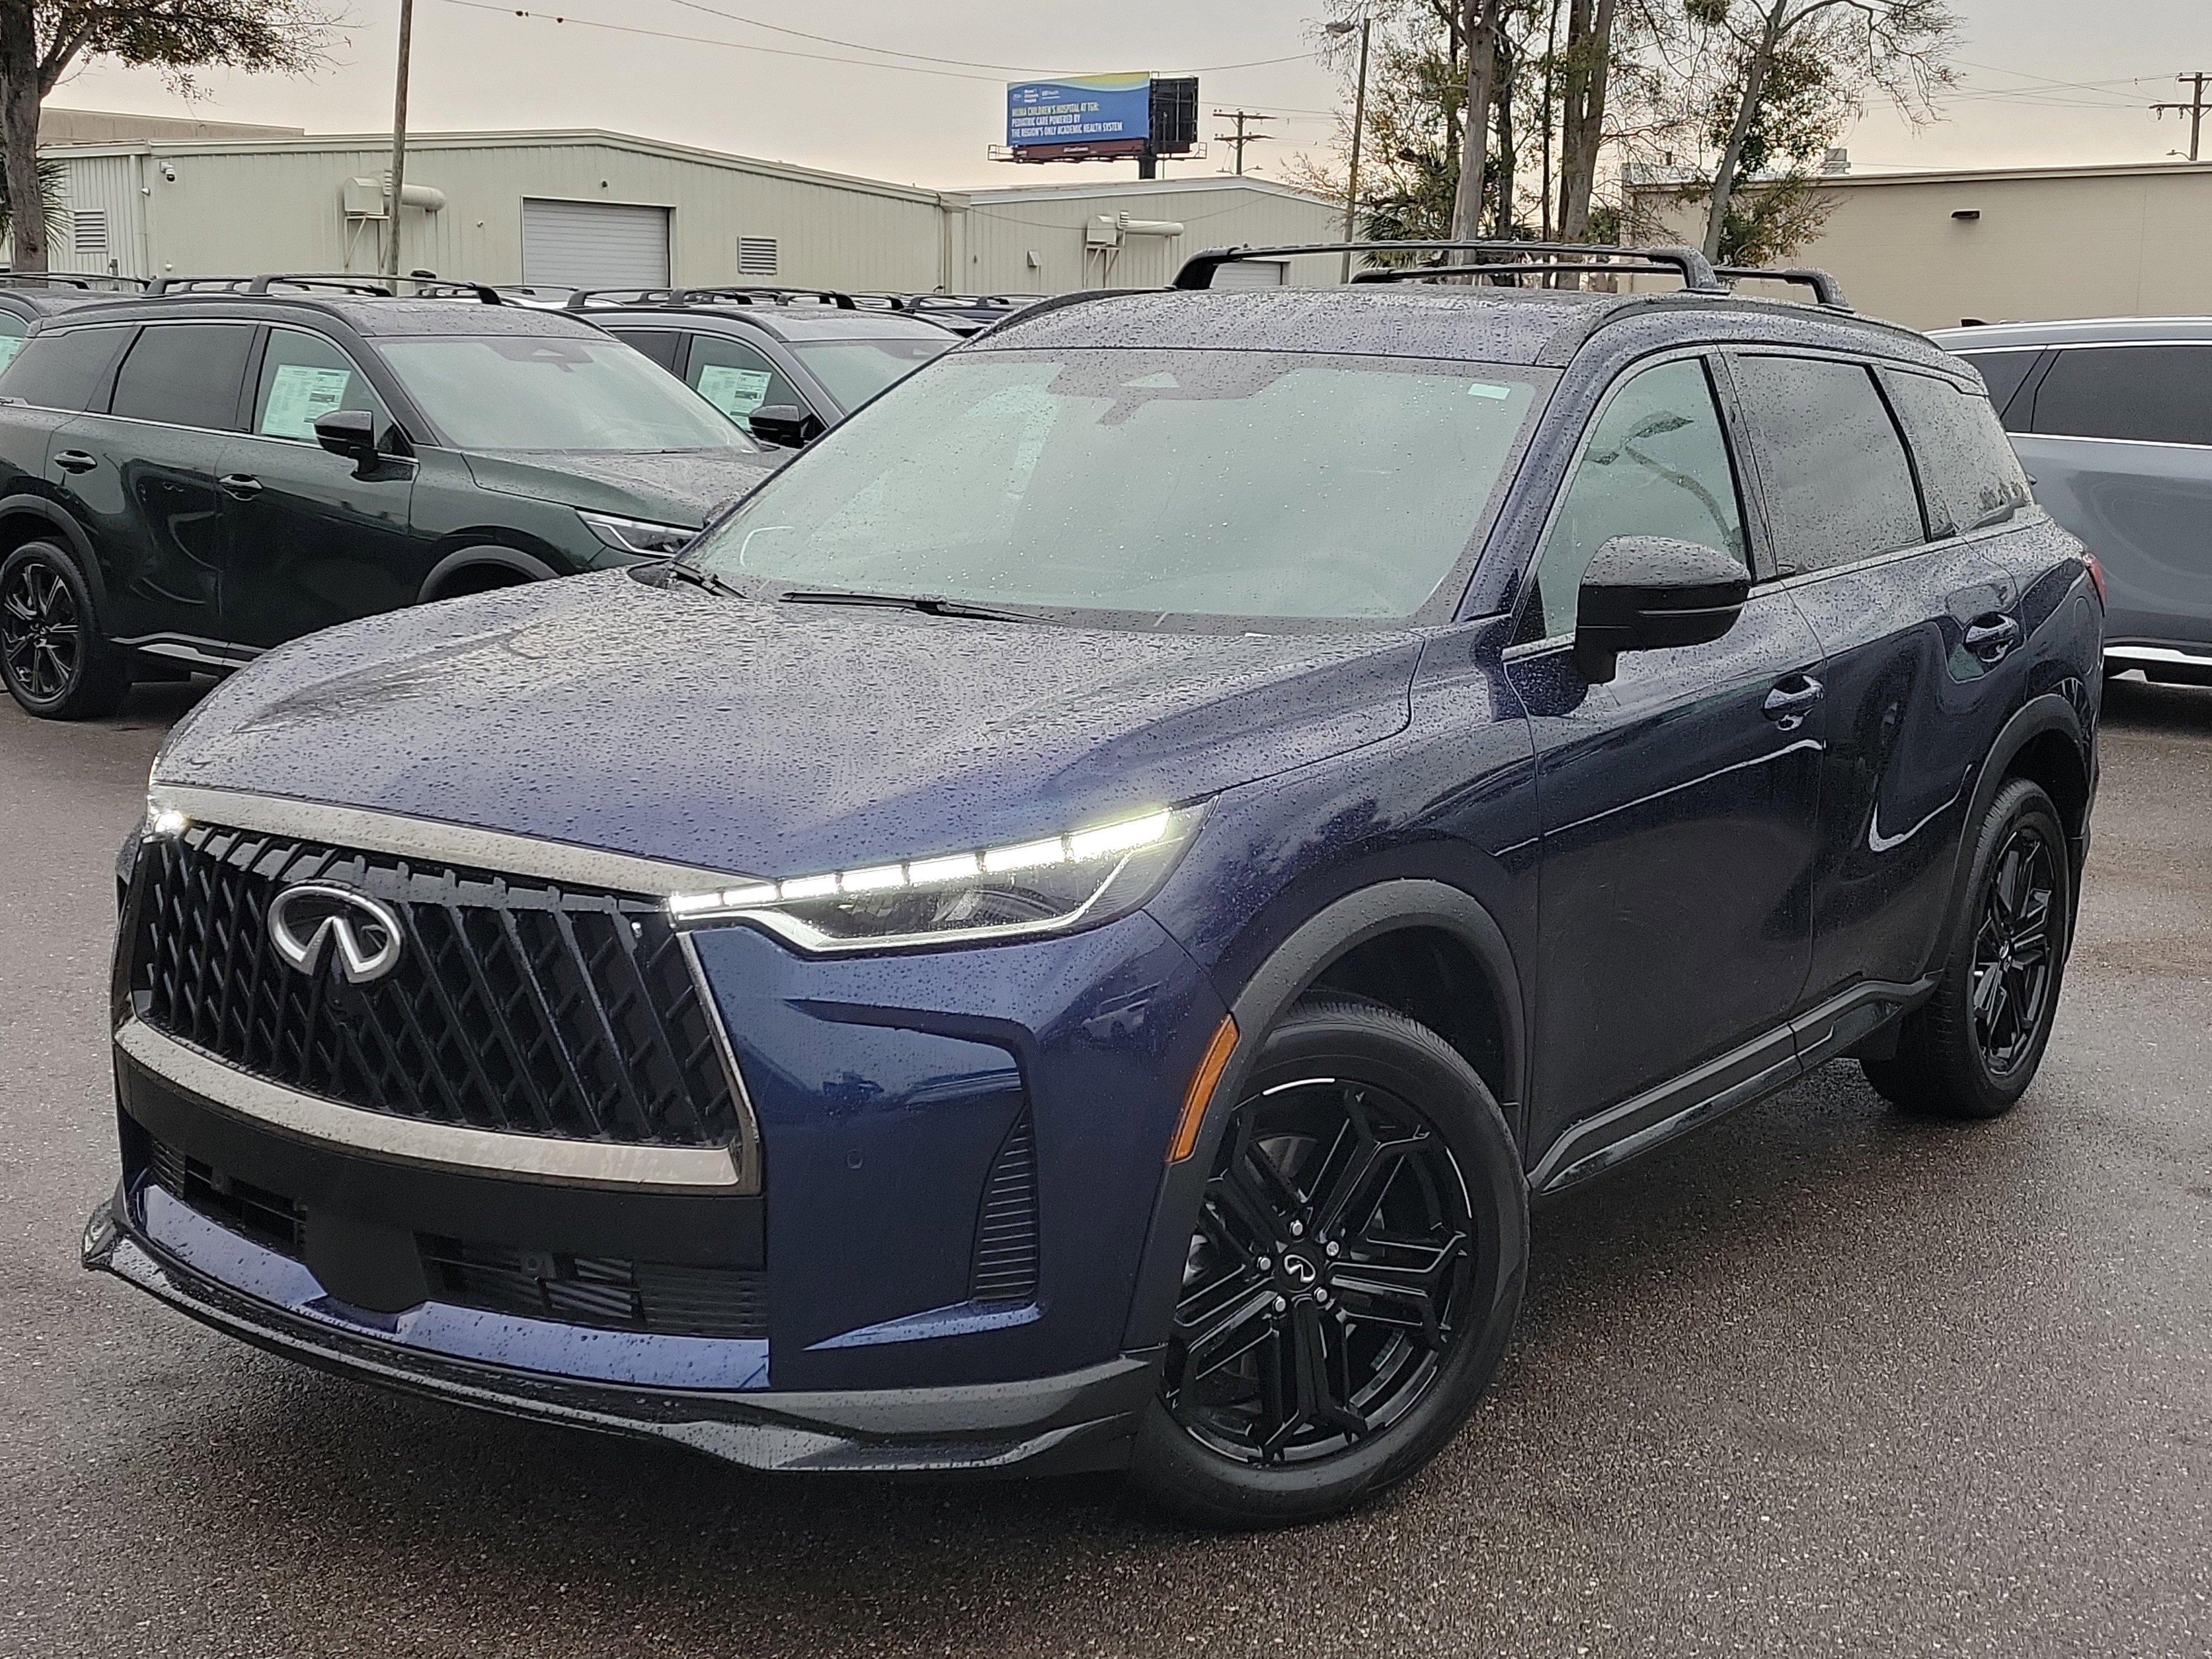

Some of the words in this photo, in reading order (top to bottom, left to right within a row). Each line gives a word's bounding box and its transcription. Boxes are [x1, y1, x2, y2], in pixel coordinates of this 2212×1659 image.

[1081, 102, 1087, 112] AT
[1036, 116, 1048, 126] CARE
[1049, 114, 1073, 125] POWERED
[1074, 114, 1081, 123] BY
[1011, 128, 1020, 138] THE
[1045, 126, 1057, 136] ONLY
[1057, 124, 1082, 135] ACADEMIC
[1083, 123, 1102, 133] HEALTH
[1103, 121, 1123, 132] SYSTEM
